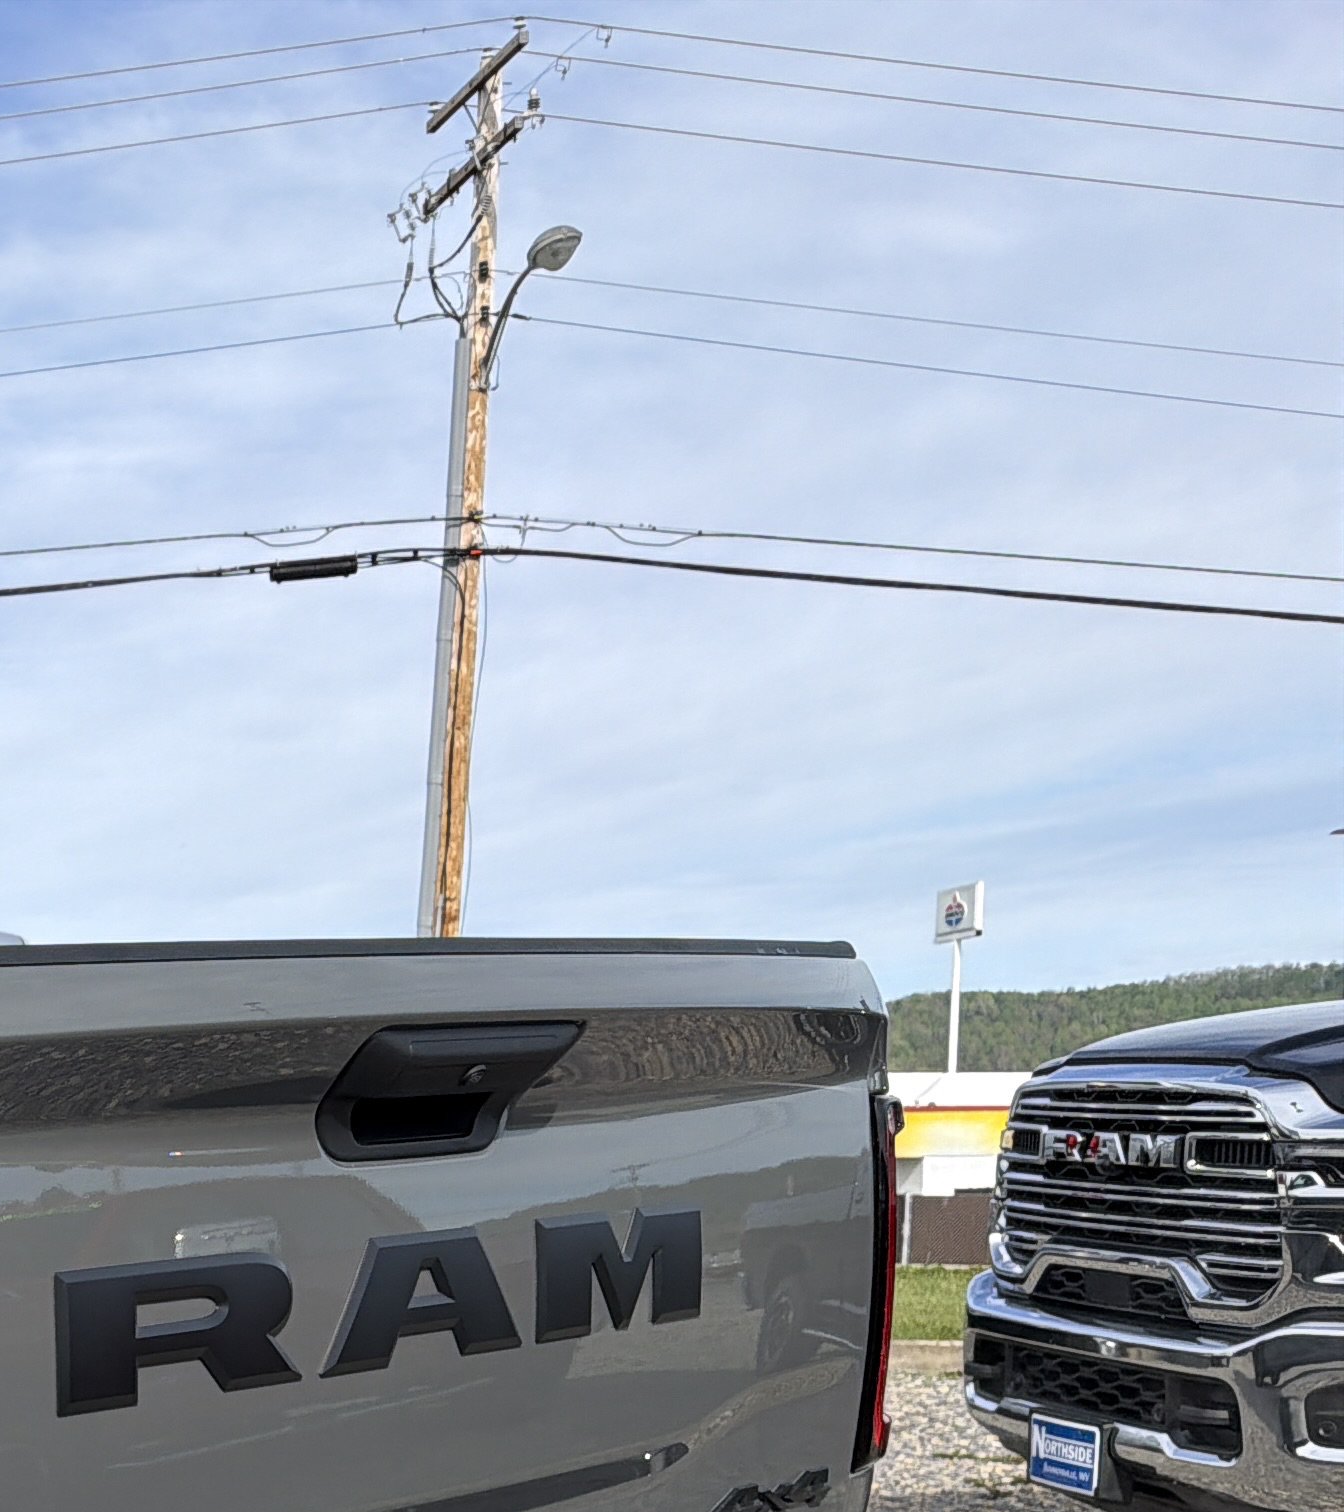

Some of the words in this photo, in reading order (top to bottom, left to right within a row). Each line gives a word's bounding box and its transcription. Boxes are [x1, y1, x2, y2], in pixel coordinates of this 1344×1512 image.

[1043, 1129, 1186, 1169] RAM
[53, 1207, 702, 1419] RAM
[1031, 1423, 1093, 1464] NORTHSIDE
